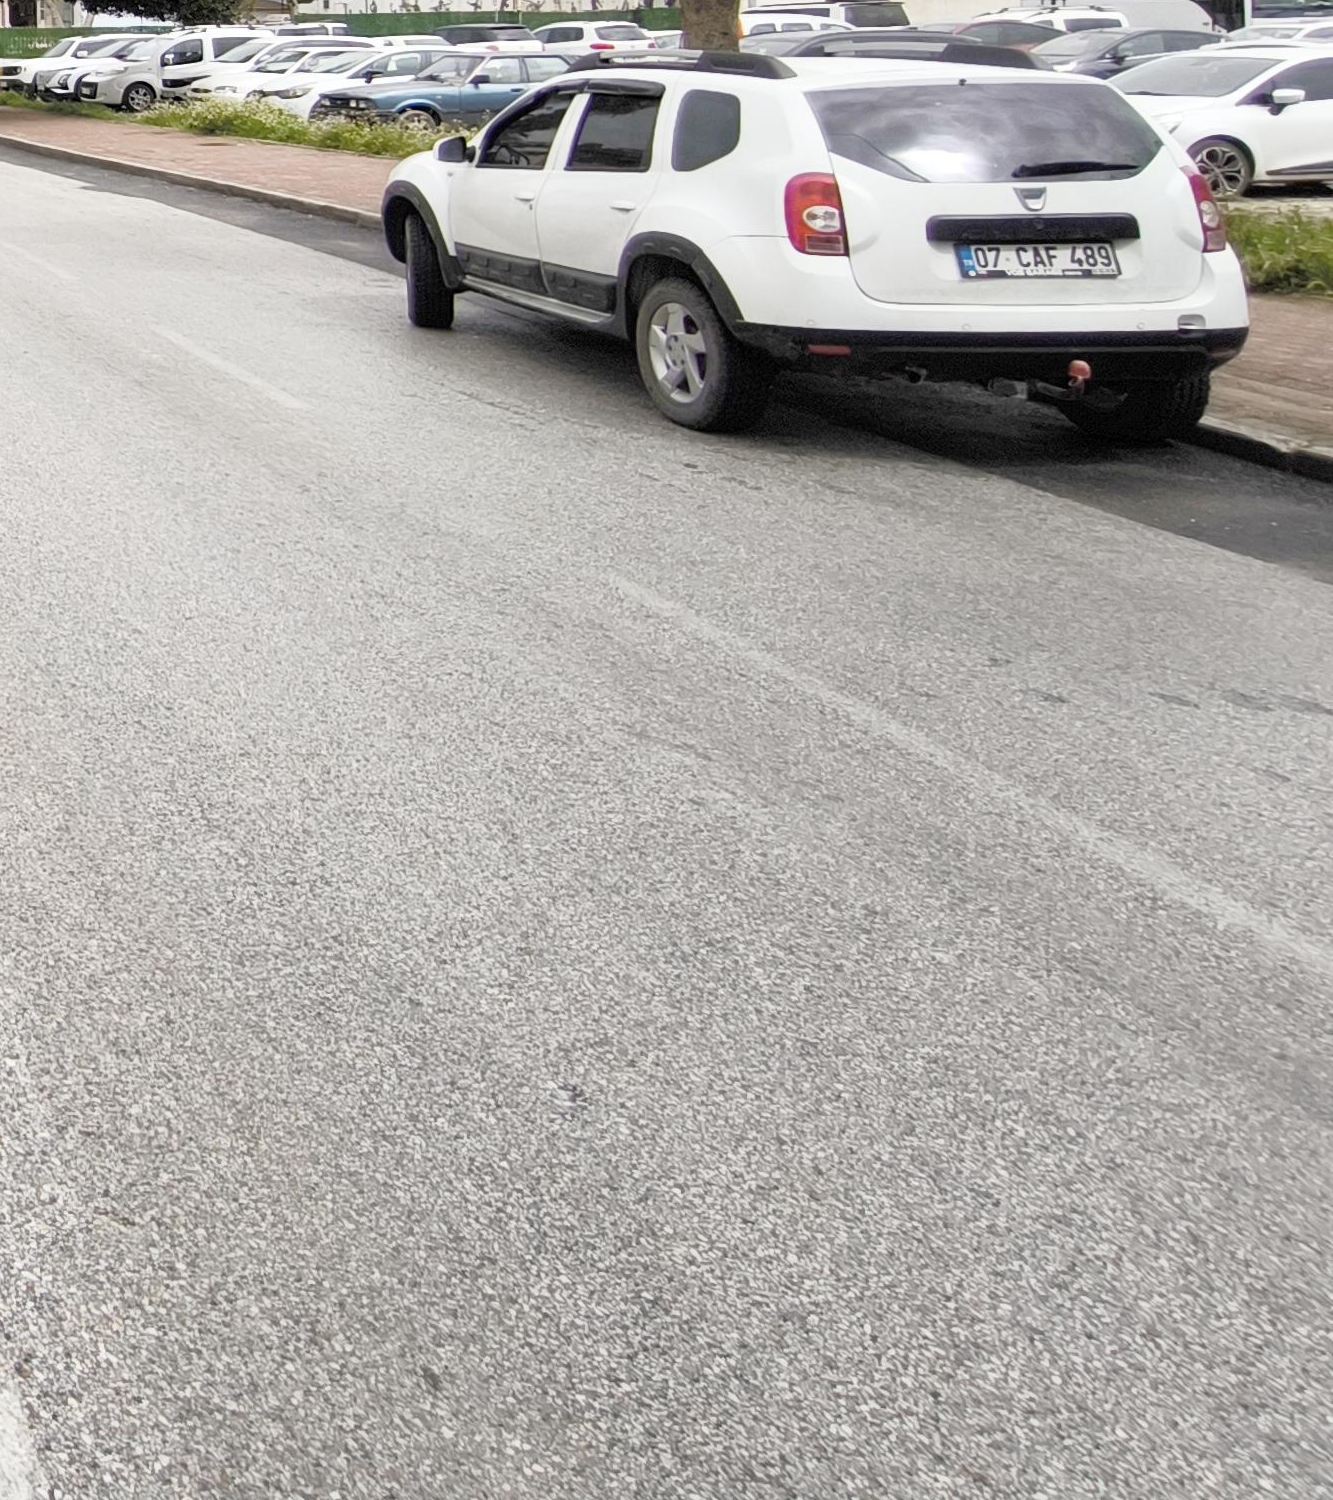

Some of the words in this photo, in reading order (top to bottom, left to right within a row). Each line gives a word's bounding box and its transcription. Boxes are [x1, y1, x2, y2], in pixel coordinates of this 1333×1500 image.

[974, 246, 1001, 269] 07
[1016, 246, 1058, 268] CAF
[1070, 245, 1113, 268] 489
